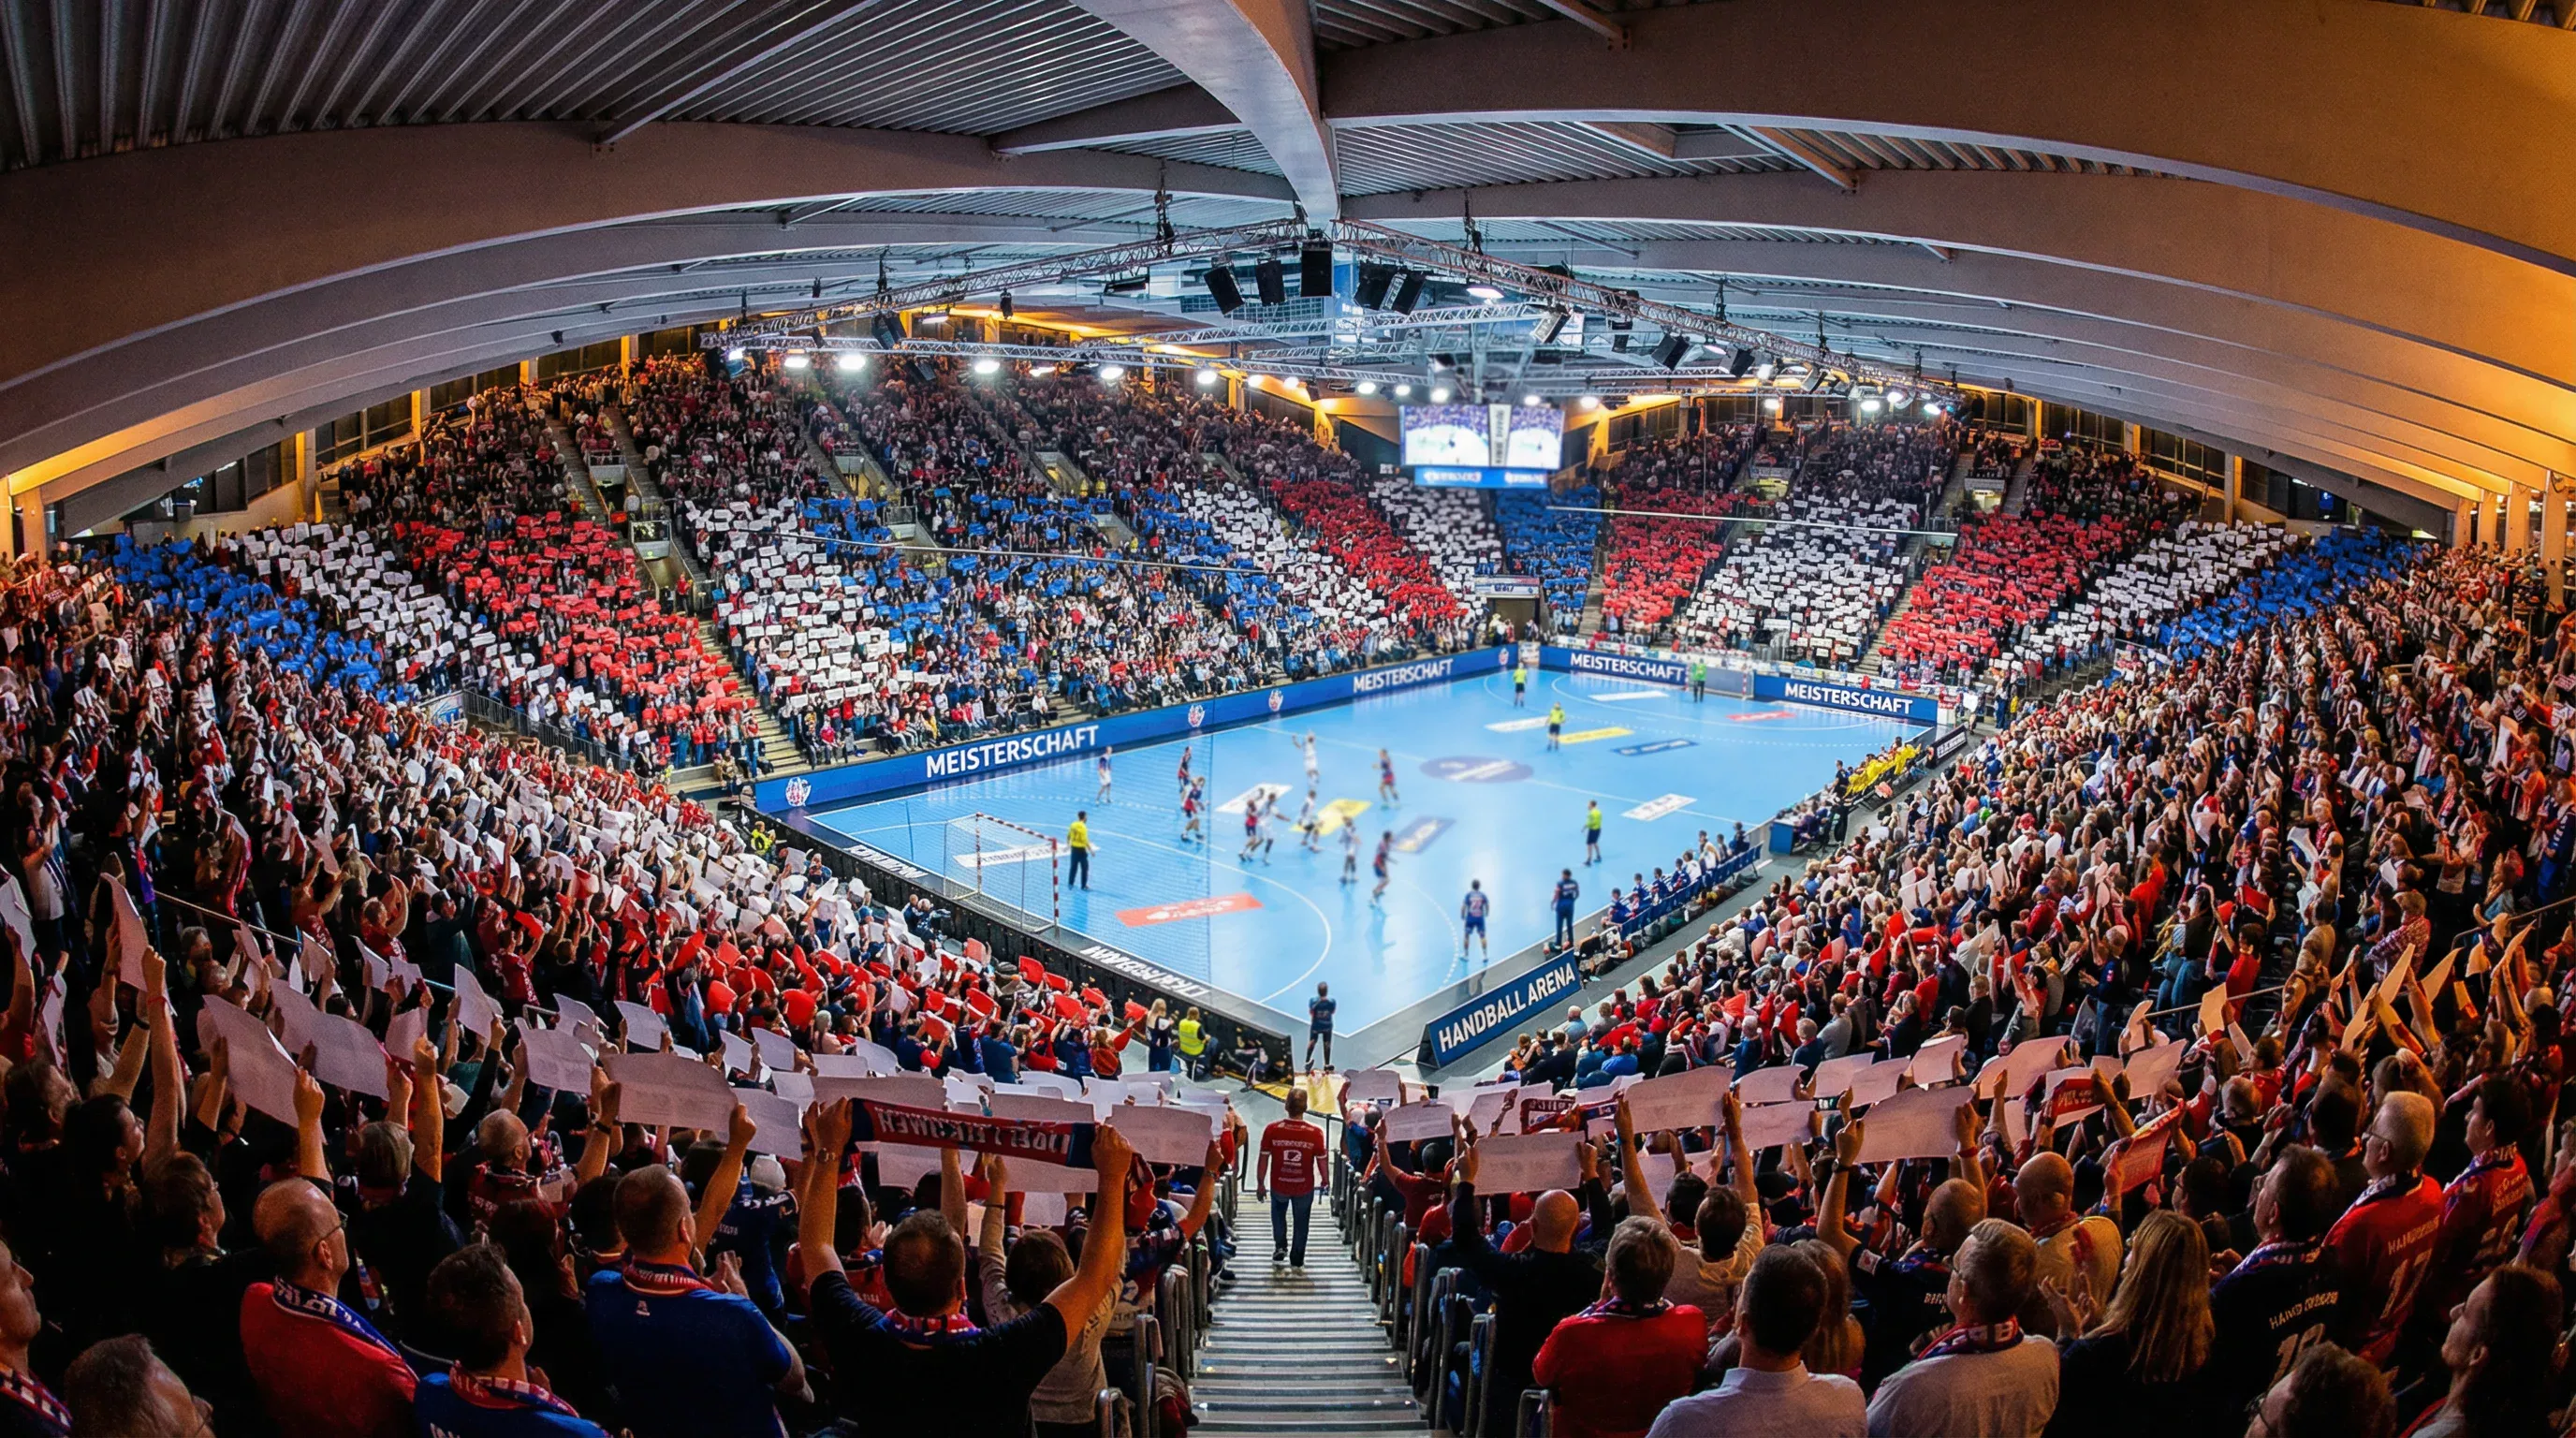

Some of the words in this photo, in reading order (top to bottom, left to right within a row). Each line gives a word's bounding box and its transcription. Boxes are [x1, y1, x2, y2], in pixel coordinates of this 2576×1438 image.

[1354, 658, 1454, 693] MEISTERSCHAFT
[1570, 653, 1684, 682] MEISTERSCHAFT
[1784, 682, 1913, 714] MEISTERSCHAFT
[927, 725, 1099, 778] MEISTERSCHAFT
[1438, 990, 1527, 1053] HANDBALL
[1528, 962, 1576, 1006] ARENA
